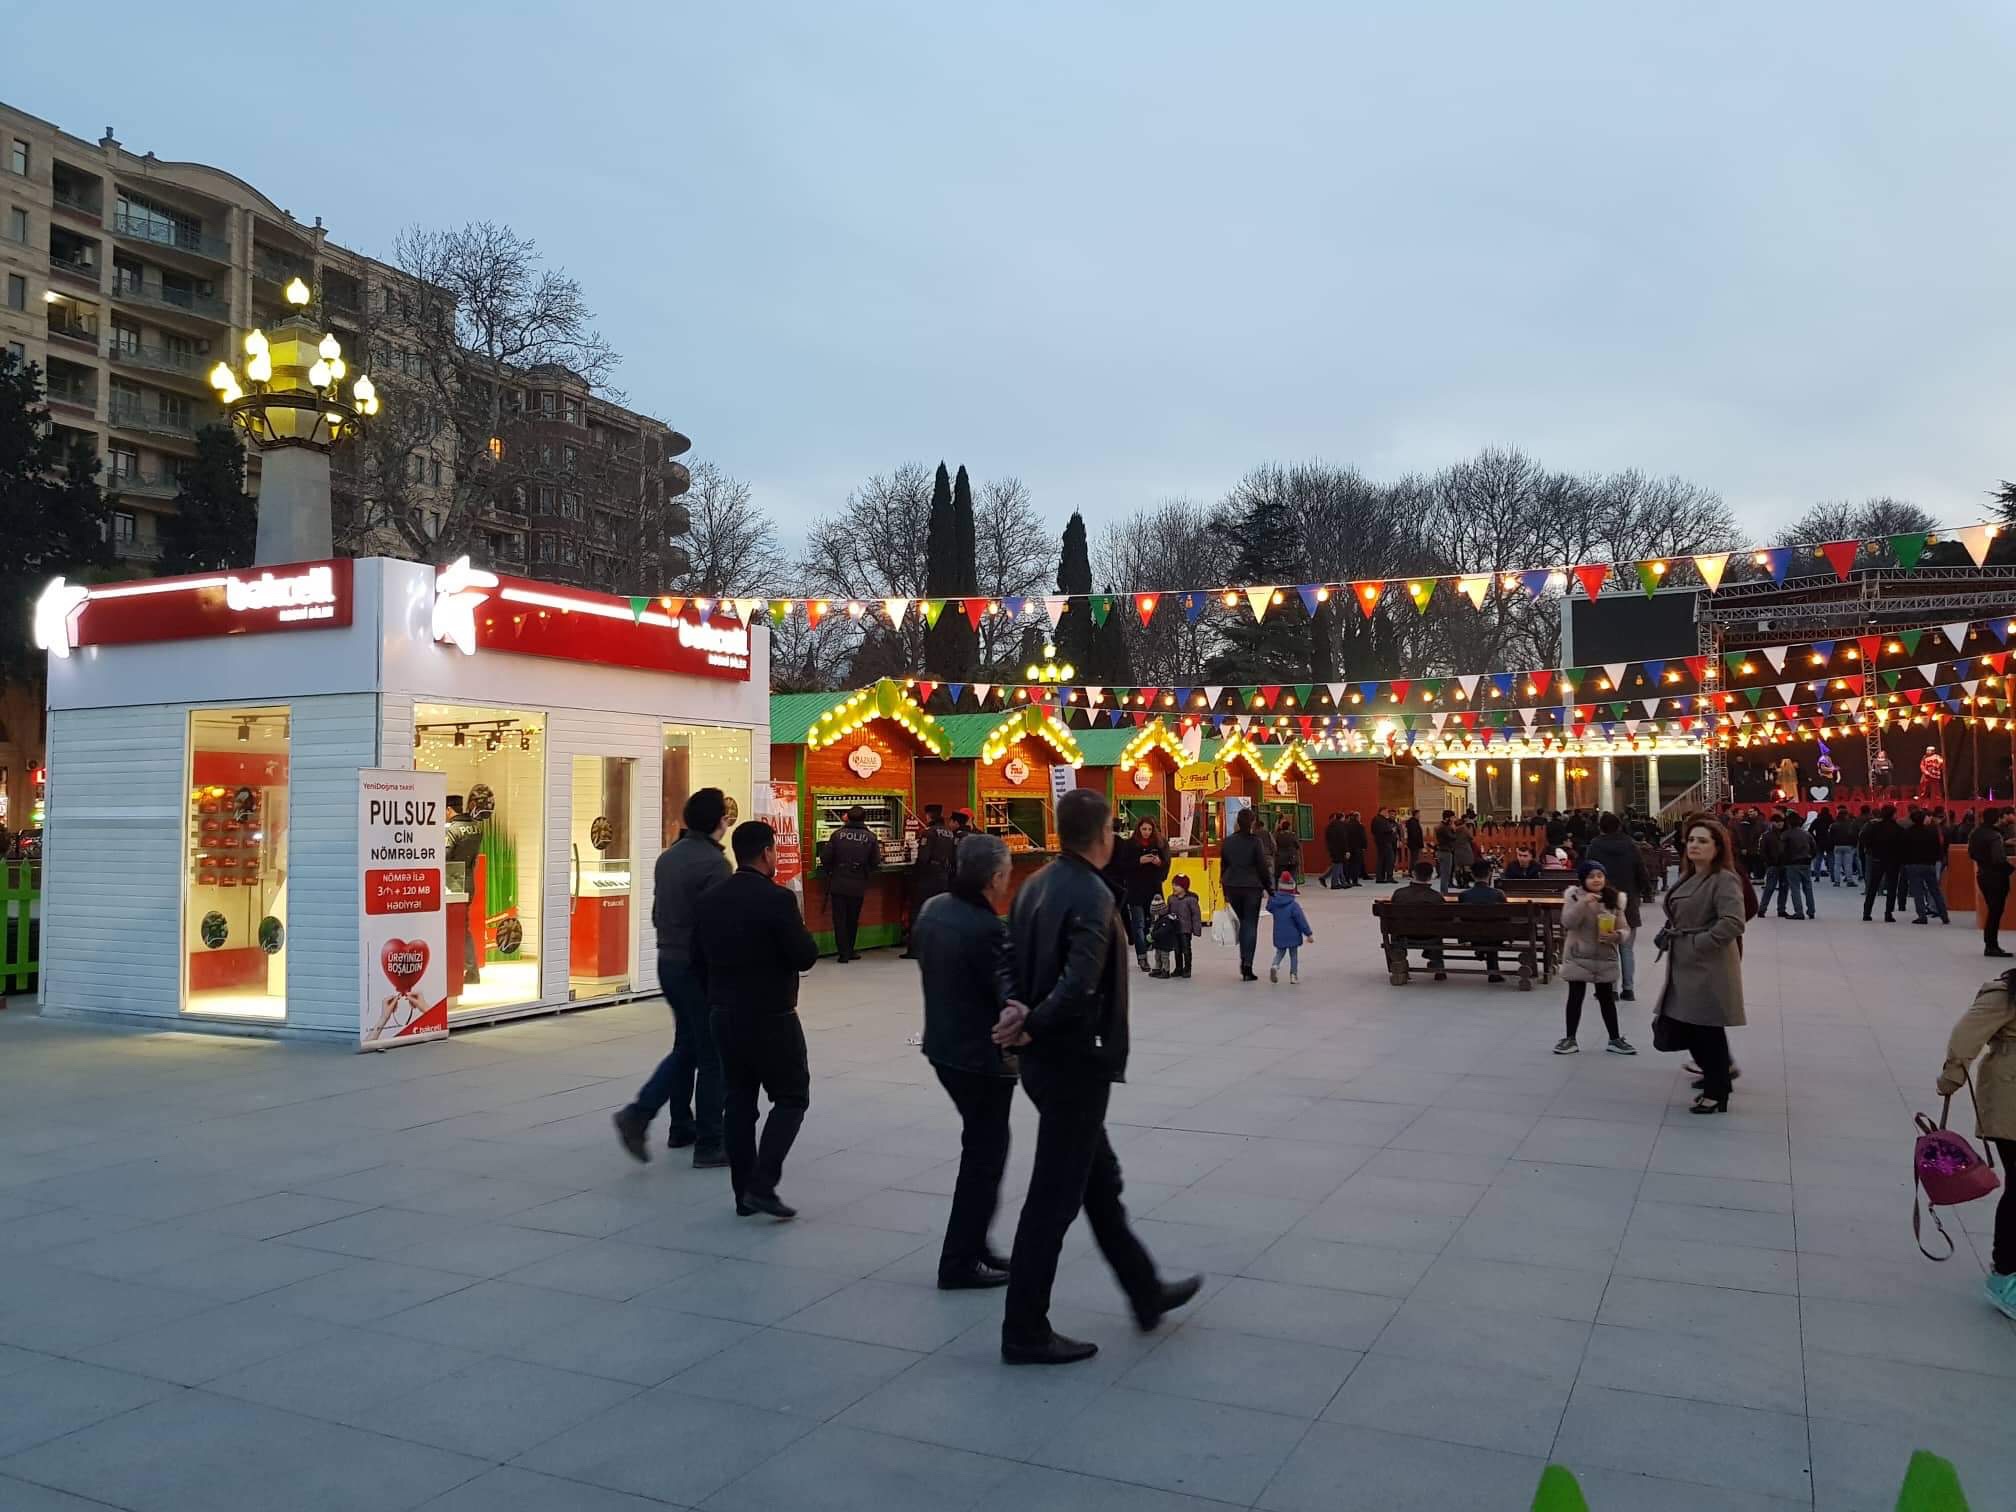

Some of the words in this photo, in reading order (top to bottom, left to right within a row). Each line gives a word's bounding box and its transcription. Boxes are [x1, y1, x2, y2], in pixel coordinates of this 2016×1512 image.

[370, 800, 436, 826] PULSUZ
[371, 846, 435, 861] NÖMRƏLƏR
[383, 872, 411, 882] NÖMRƏ
